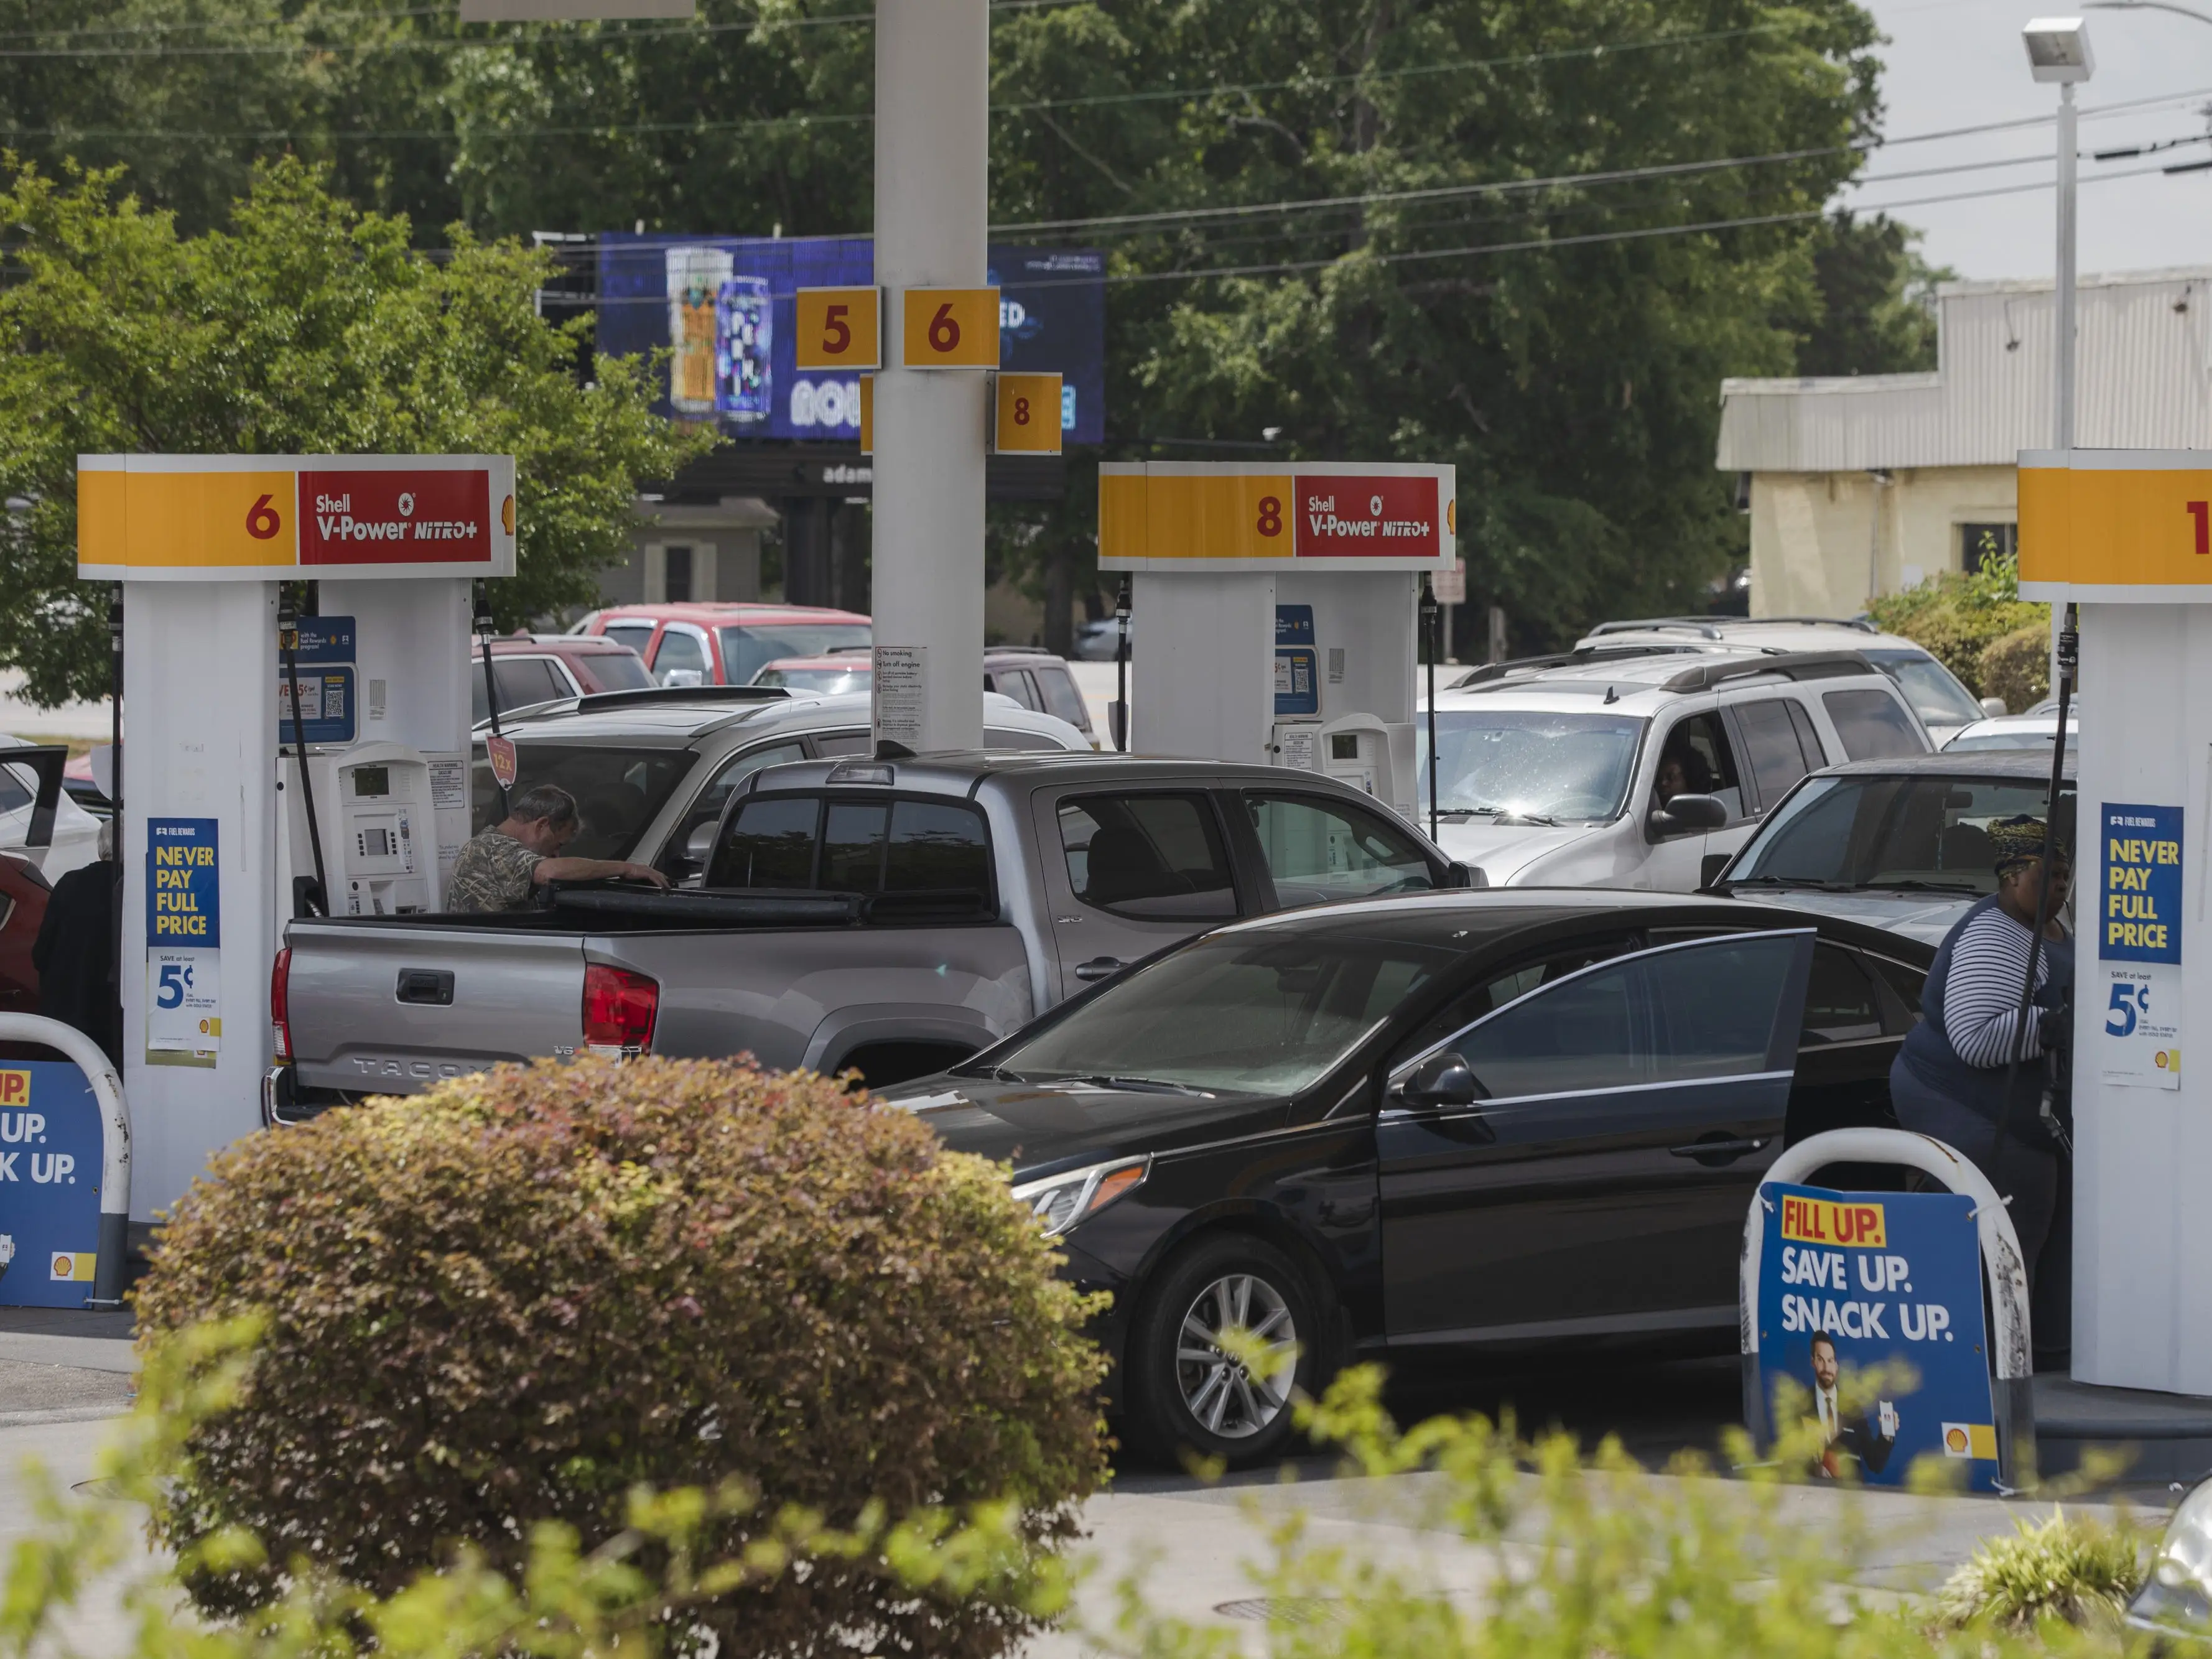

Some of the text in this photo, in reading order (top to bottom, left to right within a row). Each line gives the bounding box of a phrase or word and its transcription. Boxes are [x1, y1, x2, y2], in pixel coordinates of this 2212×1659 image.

[823, 305, 850, 354] 5
[929, 304, 960, 353] 6
[1014, 397, 1030, 425] 8
[316, 494, 350, 513] Shell
[1309, 496, 1334, 512] Shell
[246, 494, 280, 540] 6
[317, 516, 408, 541] V-Power
[1257, 496, 1283, 537] 8
[1309, 514, 1378, 536] V-Power
[493, 753, 513, 771] 12x
[177, 828, 195, 836] REWARDS
[2124, 816, 2135, 826] FUEL
[156, 847, 214, 865] NEVER
[2110, 839, 2179, 865] NEVER
[157, 870, 193, 888] PAY
[2109, 867, 2152, 891] PAY
[157, 893, 198, 911] FULL
[2109, 895, 2158, 919] FULL
[157, 915, 207, 934] PRICE
[2109, 922, 2167, 948] PRICE
[157, 965, 193, 1009] 5¢
[2111, 971, 2128, 979] SAVE
[2137, 972, 2152, 980] least
[2105, 983, 2149, 1038] 5¢
[554, 1046, 574, 1055] V6
[1, 1112, 47, 1144] UP.
[31, 1153, 75, 1184] UP.
[1785, 1200, 1881, 1243] FILL UP.
[1782, 1246, 1912, 1293] SAVE UP.
[1782, 1293, 1953, 1342] SNACK UP.
